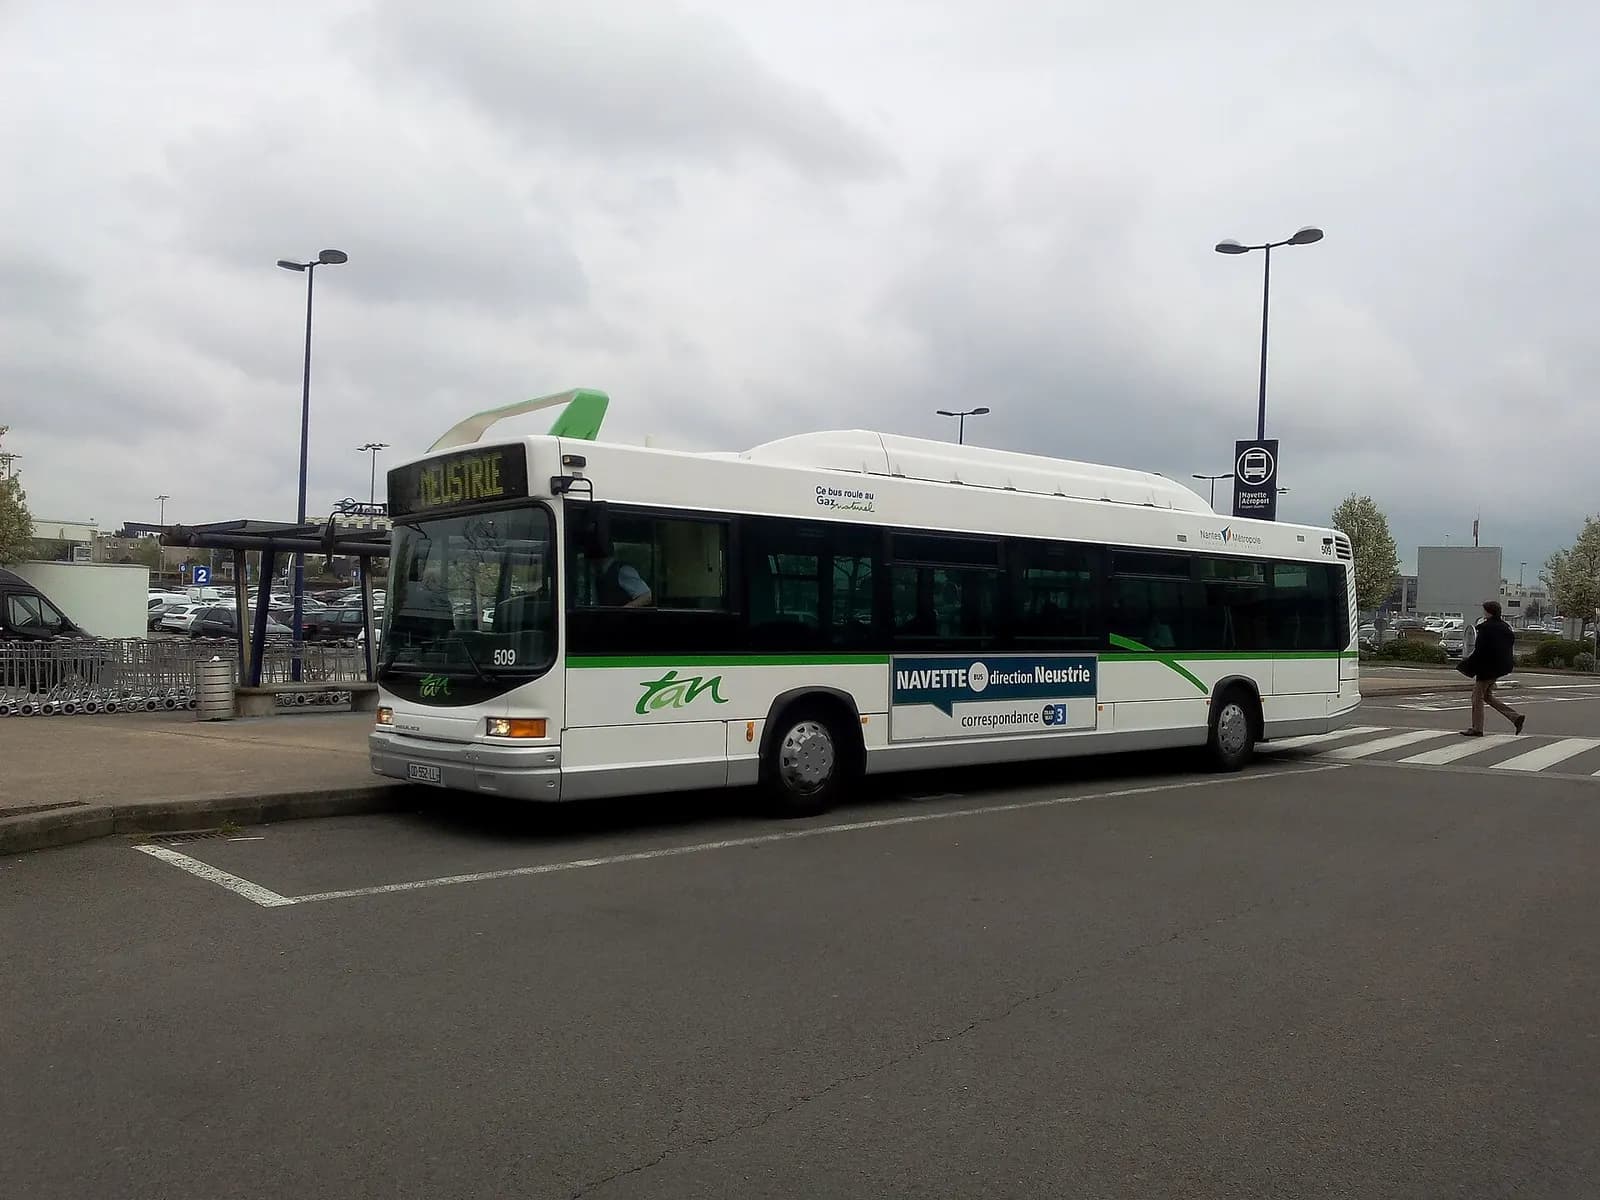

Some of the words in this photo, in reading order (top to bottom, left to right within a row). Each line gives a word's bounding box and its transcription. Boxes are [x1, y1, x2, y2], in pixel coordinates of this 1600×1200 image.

[816, 486, 826, 495] Ce
[828, 488, 842, 497] bus
[844, 490, 863, 499] roule
[816, 495, 835, 506] Gaz
[1200, 530, 1221, 541] Nantes
[1321, 545, 1332, 556] 509
[197, 569, 207, 582] 2
[493, 649, 516, 666] 509
[896, 669, 967, 690] NAVETTE
[973, 673, 984, 681] BUS
[989, 670, 1033, 685] direction
[1034, 664, 1091, 684] Neustrie
[419, 673, 450, 697] tan
[635, 671, 729, 714] tan
[961, 710, 1039, 728] correspondance
[1057, 708, 1063, 722] 3
